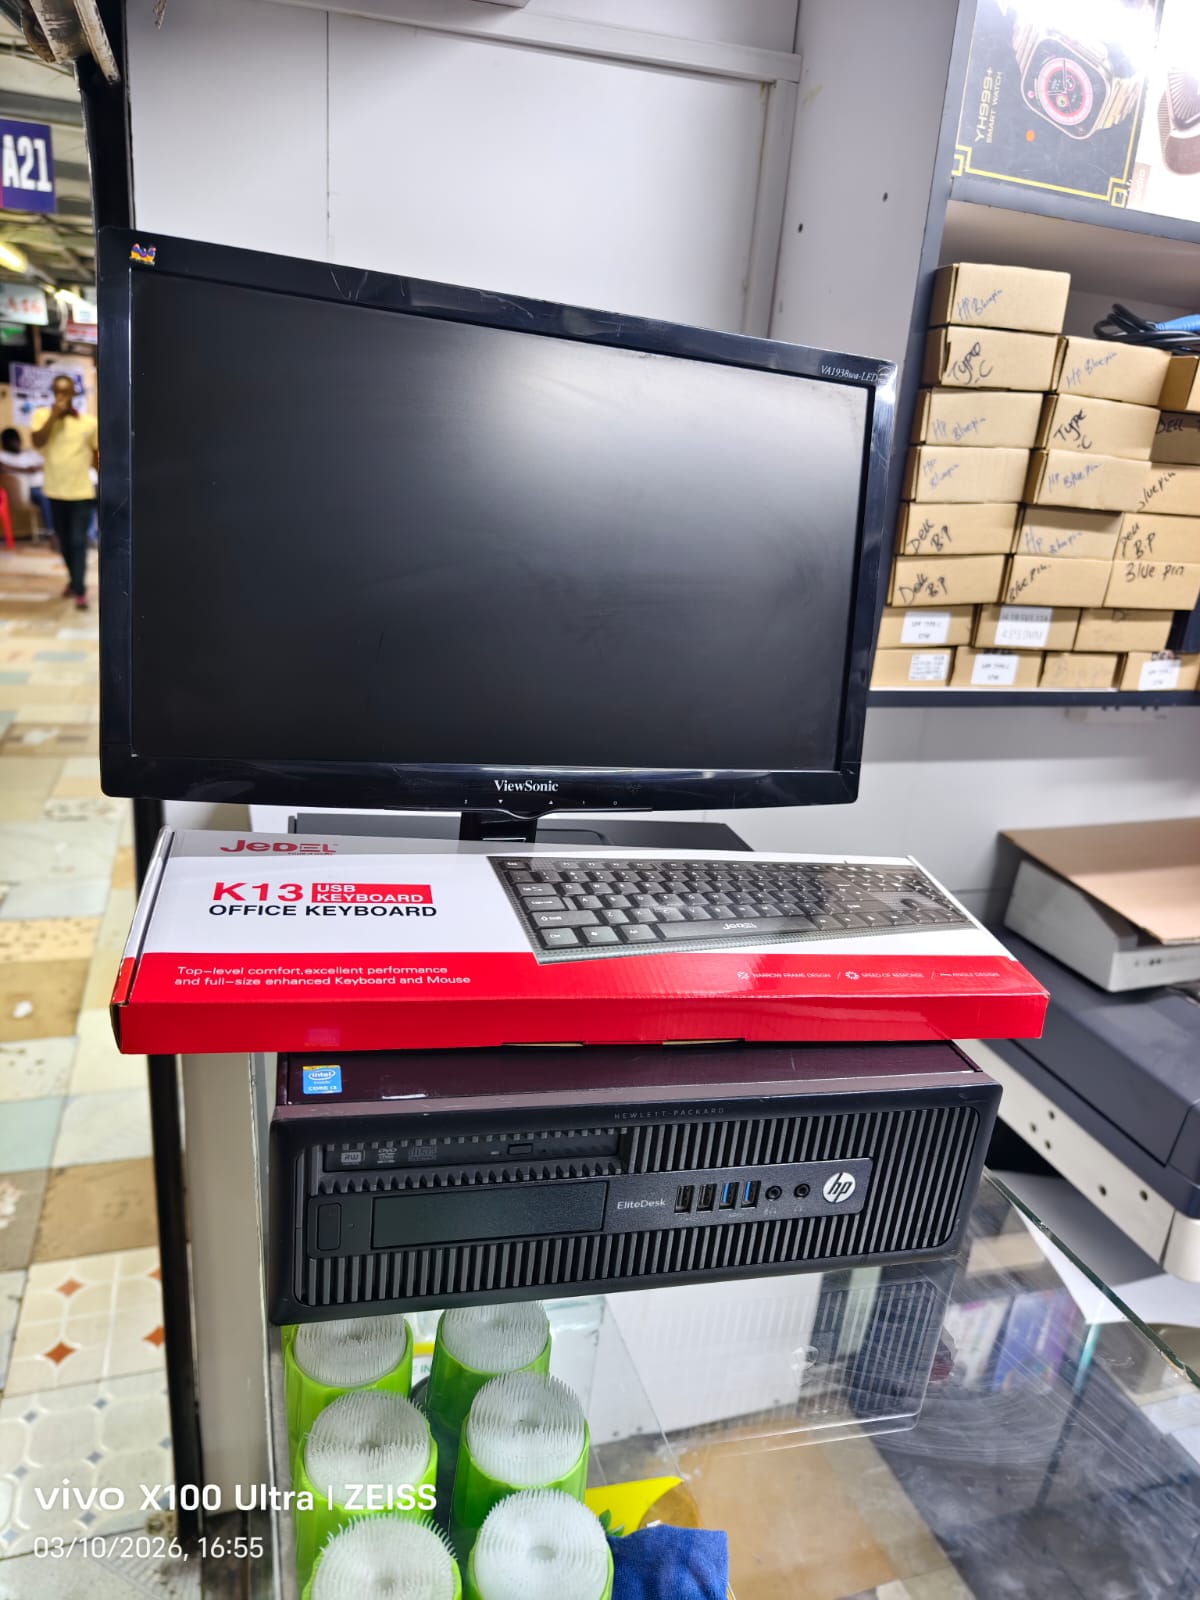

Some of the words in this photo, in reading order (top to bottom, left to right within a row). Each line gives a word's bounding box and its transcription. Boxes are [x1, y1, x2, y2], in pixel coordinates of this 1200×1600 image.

[973, 66, 993, 143] YH999+
[2, 133, 53, 193] A21
[1052, 408, 1088, 442] Type
[494, 780, 559, 792] ViewSonic
[213, 882, 305, 902] K13
[316, 884, 357, 893] USB
[316, 893, 424, 903] KEYBOARD
[209, 904, 297, 916] OFFICE
[306, 905, 437, 917] KEYBOARD
[177, 966, 245, 977] Top-level
[367, 965, 448, 976] performance
[174, 977, 201, 986] and
[204, 976, 261, 986] full-size
[264, 976, 331, 986] enhanced
[334, 976, 396, 987] Keyboard
[399, 975, 424, 985] and
[426, 975, 472, 985] Mouse
[616, 1198, 667, 1210] EliteDesk
